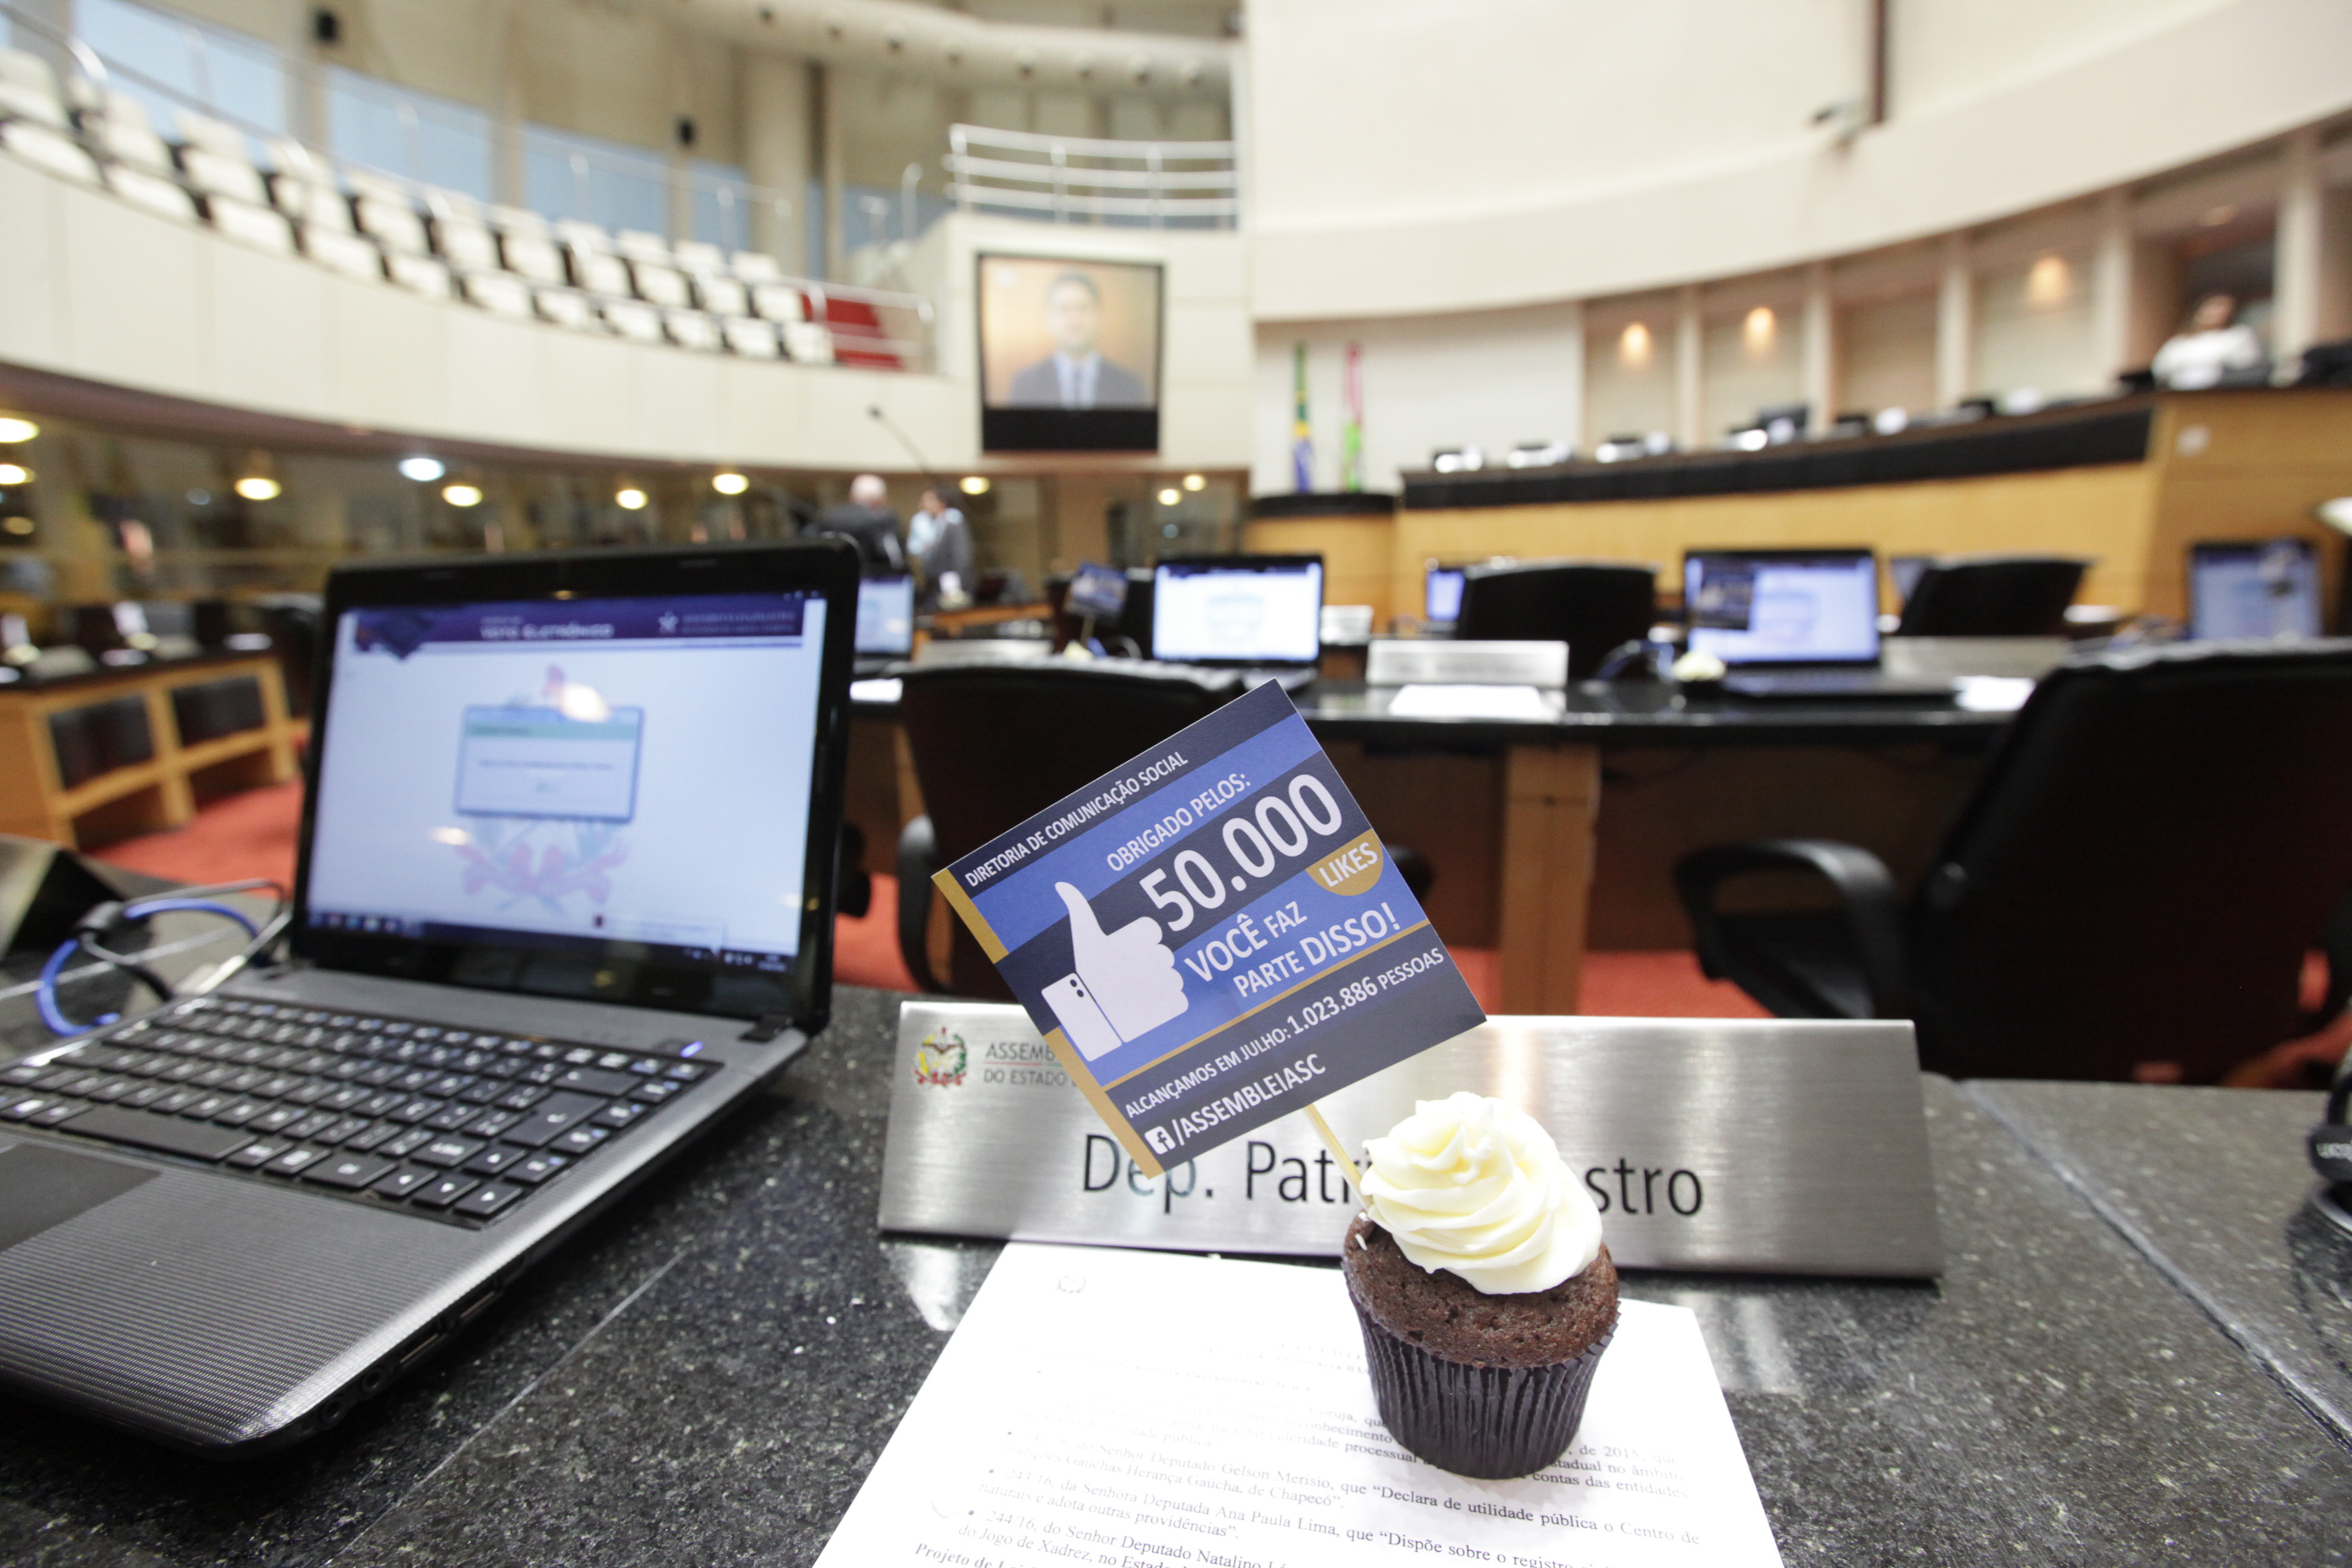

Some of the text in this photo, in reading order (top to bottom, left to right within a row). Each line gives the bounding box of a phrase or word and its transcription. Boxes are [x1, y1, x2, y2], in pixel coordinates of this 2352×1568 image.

[965, 751, 1189, 887] DIRETORIA DE COMUNICAÇÃO SOCIAL
[1107, 773, 1251, 871] OBRIGADO PELOS:
[1139, 774, 1342, 932] 50.000
[1319, 841, 1379, 887] LIKES
[1184, 901, 1308, 982] VOCÊ FAZ
[1233, 902, 1401, 997] PARTE DISSO!
[985, 1042, 1056, 1062] ASSEMB
[1124, 947, 1445, 1119] ALCANÇAMOS EM JULHO: 1.023.886 PESSOAS
[983, 1069, 1004, 1084] DO
[1010, 1070, 1067, 1087] ESTADO
[1585, 1157, 1703, 1217] stro
[1364, 1417, 1384, 1429] qu
[1579, 1444, 1597, 1456] de
[1126, 1465, 1182, 1484] Herança
[1248, 1484, 1266, 1496] de
[1344, 1441, 1417, 1463] processual
[1533, 1473, 1580, 1485] contas
[1585, 1476, 1611, 1489] das
[1616, 1482, 1688, 1499] entidades
[1550, 1459, 1602, 1472] stadual
[1608, 1464, 1626, 1474] no
[979, 1484, 1032, 1501] naturais
[1036, 1494, 1044, 1503] e
[1048, 1495, 1085, 1511] adota
[1089, 1504, 1131, 1520] outras
[1006, 1469, 1054, 1489] 24316,
[1061, 1478, 1077, 1491] da
[1081, 1482, 1138, 1502] Senhora
[1143, 1493, 1210, 1516] Deputada
[1215, 1506, 1245, 1522] Ana
[1251, 1511, 1292, 1527] Paula
[1297, 1517, 1340, 1538] Lima,
[1346, 1528, 1375, 1543] que
[1448, 1544, 1491, 1561] sobre
[1496, 1554, 1506, 1564] o
[1099, 1444, 1146, 1462] Senhor
[1151, 1452, 1216, 1473] Deputado
[1222, 1463, 1270, 1479] Gelson
[1277, 1471, 1335, 1491] Merisio,
[1341, 1483, 1367, 1495] que
[1443, 1497, 1462, 1511] de
[1467, 1503, 1534, 1522] utilidade
[1540, 1513, 1598, 1530] pública
[1604, 1523, 1614, 1533] o
[1620, 1522, 1674, 1541] Centro
[1681, 1531, 1701, 1544] de
[914, 1543, 970, 1565] Projeto
[958, 1523, 976, 1537] do
[979, 1527, 1013, 1547] Jogo
[1016, 1536, 1034, 1549] de
[1037, 1538, 1092, 1564] Xadrez,
[1097, 1554, 1117, 1566] no
[1043, 1522, 1061, 1535] do
[1065, 1526, 1117, 1545] Senhor
[1120, 1535, 1192, 1560] Deputado
[1196, 1549, 1262, 1568] Natalino
